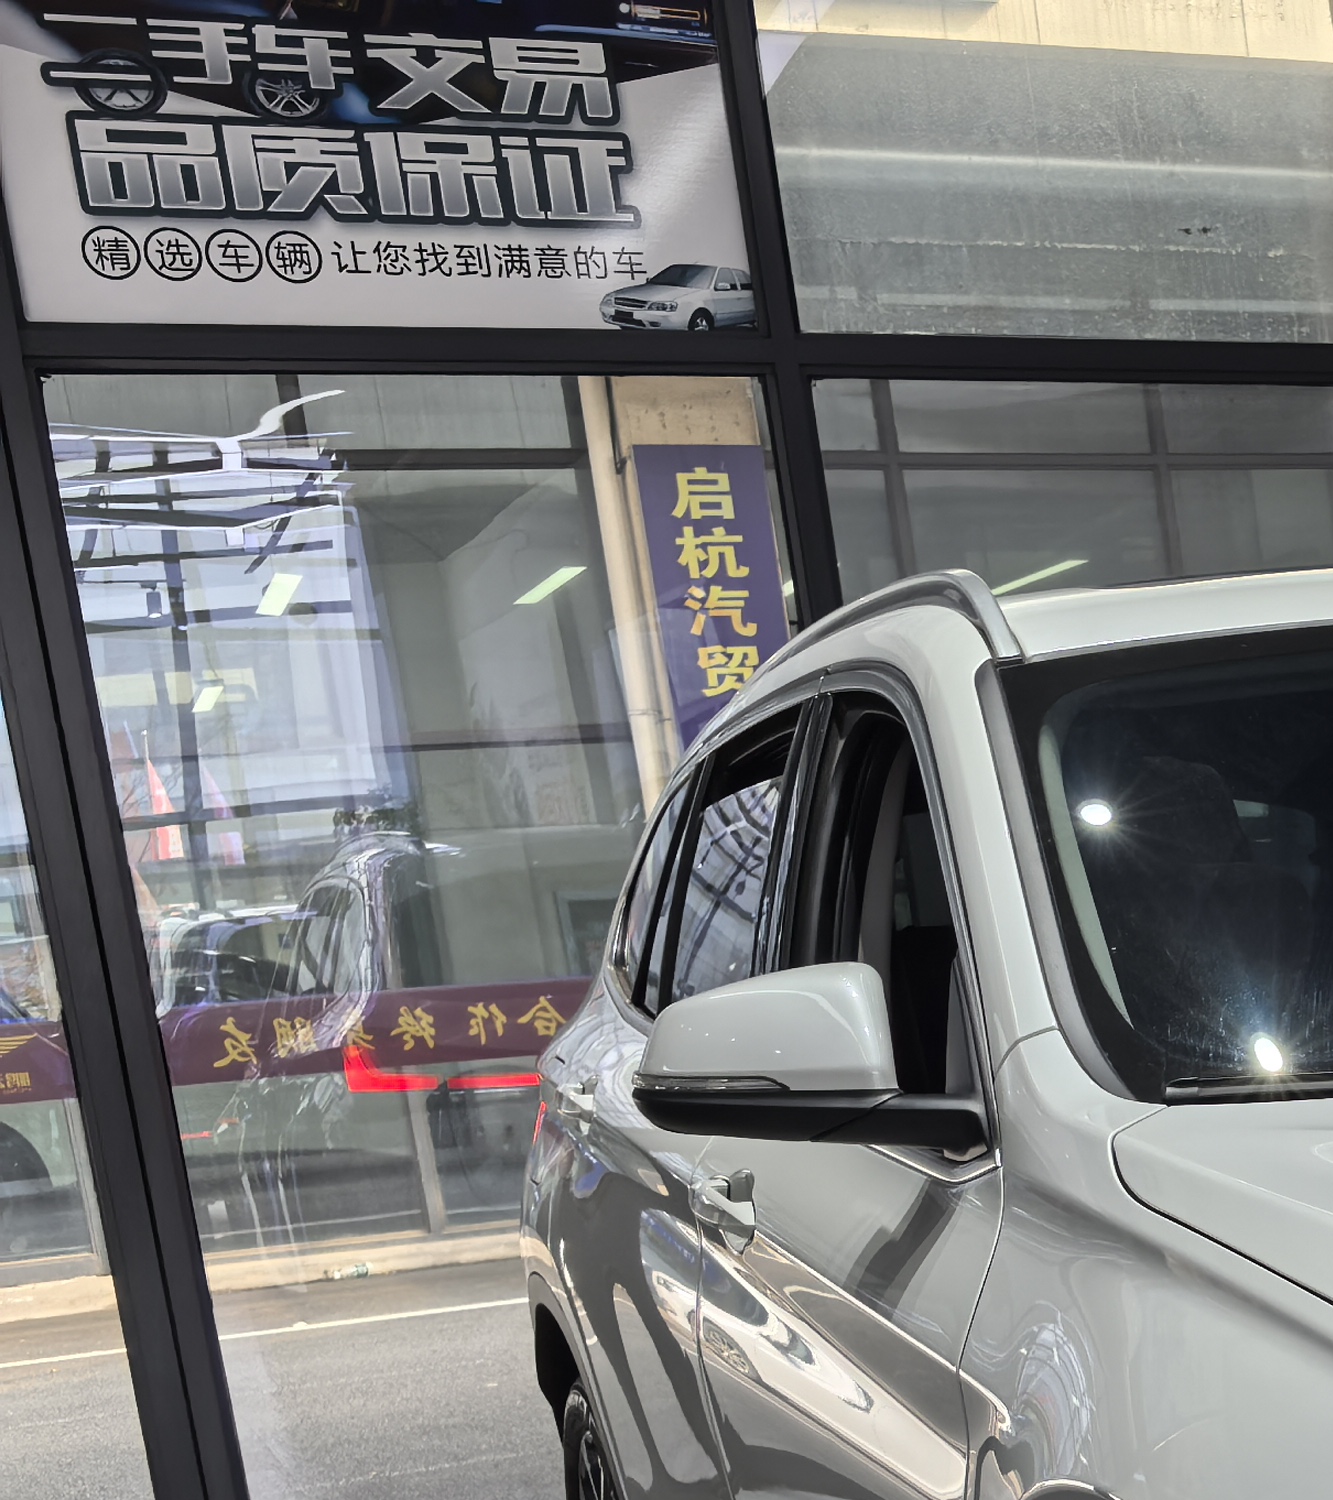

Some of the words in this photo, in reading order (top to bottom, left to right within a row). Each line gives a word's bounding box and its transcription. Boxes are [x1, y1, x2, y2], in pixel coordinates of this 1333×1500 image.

[43, 13, 613, 119] 二手车交易
[74, 118, 635, 222] 品质保证
[671, 467, 760, 697] 启杭汽贸
